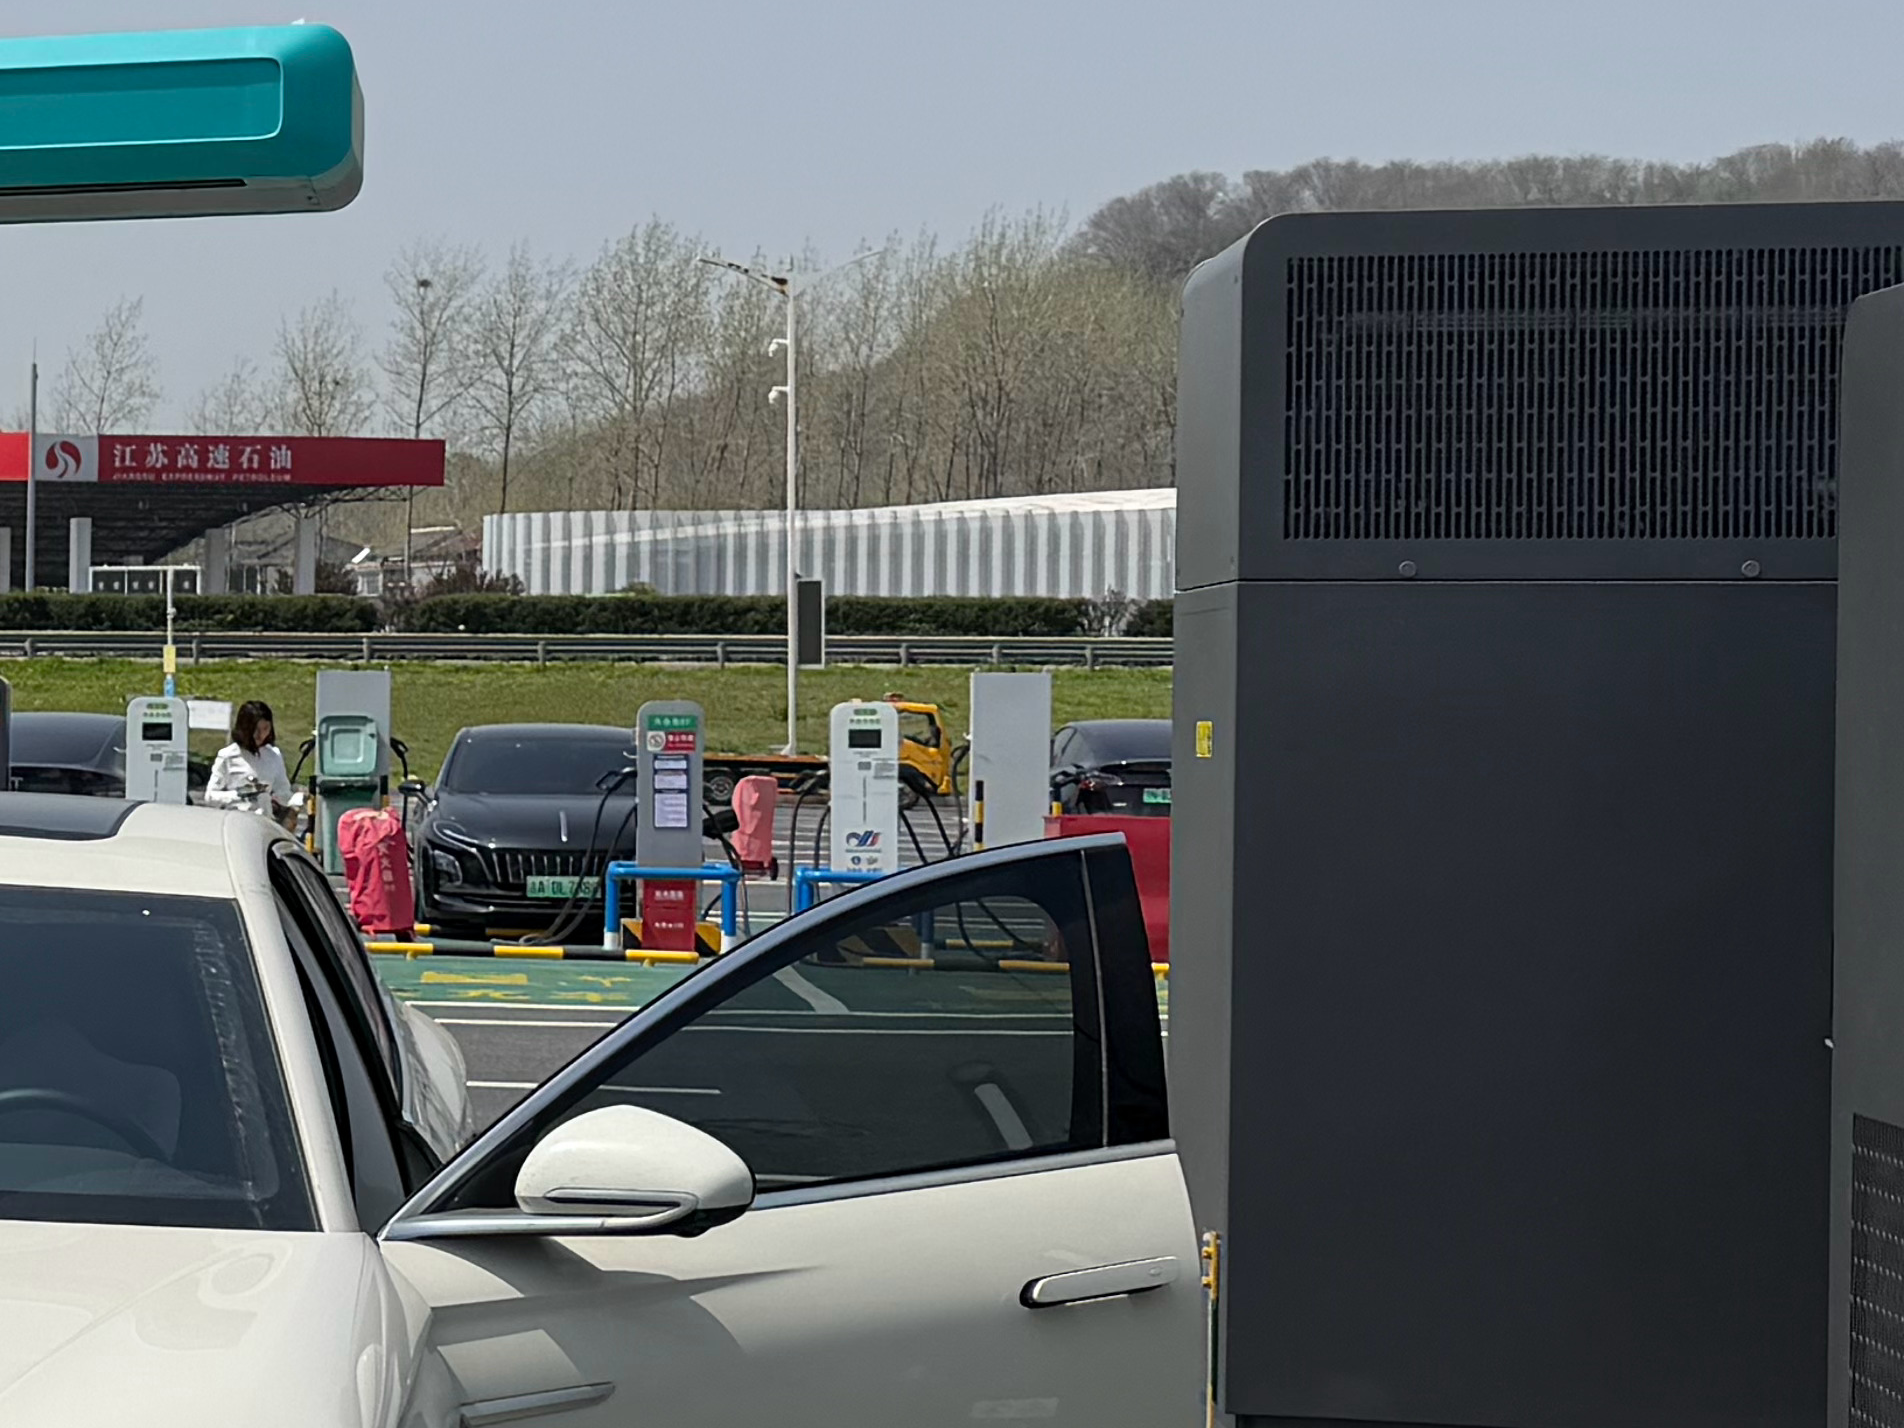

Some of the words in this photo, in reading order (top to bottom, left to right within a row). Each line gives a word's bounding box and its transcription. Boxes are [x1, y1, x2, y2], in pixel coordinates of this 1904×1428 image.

[113, 442, 292, 470] 江苏高速石油
